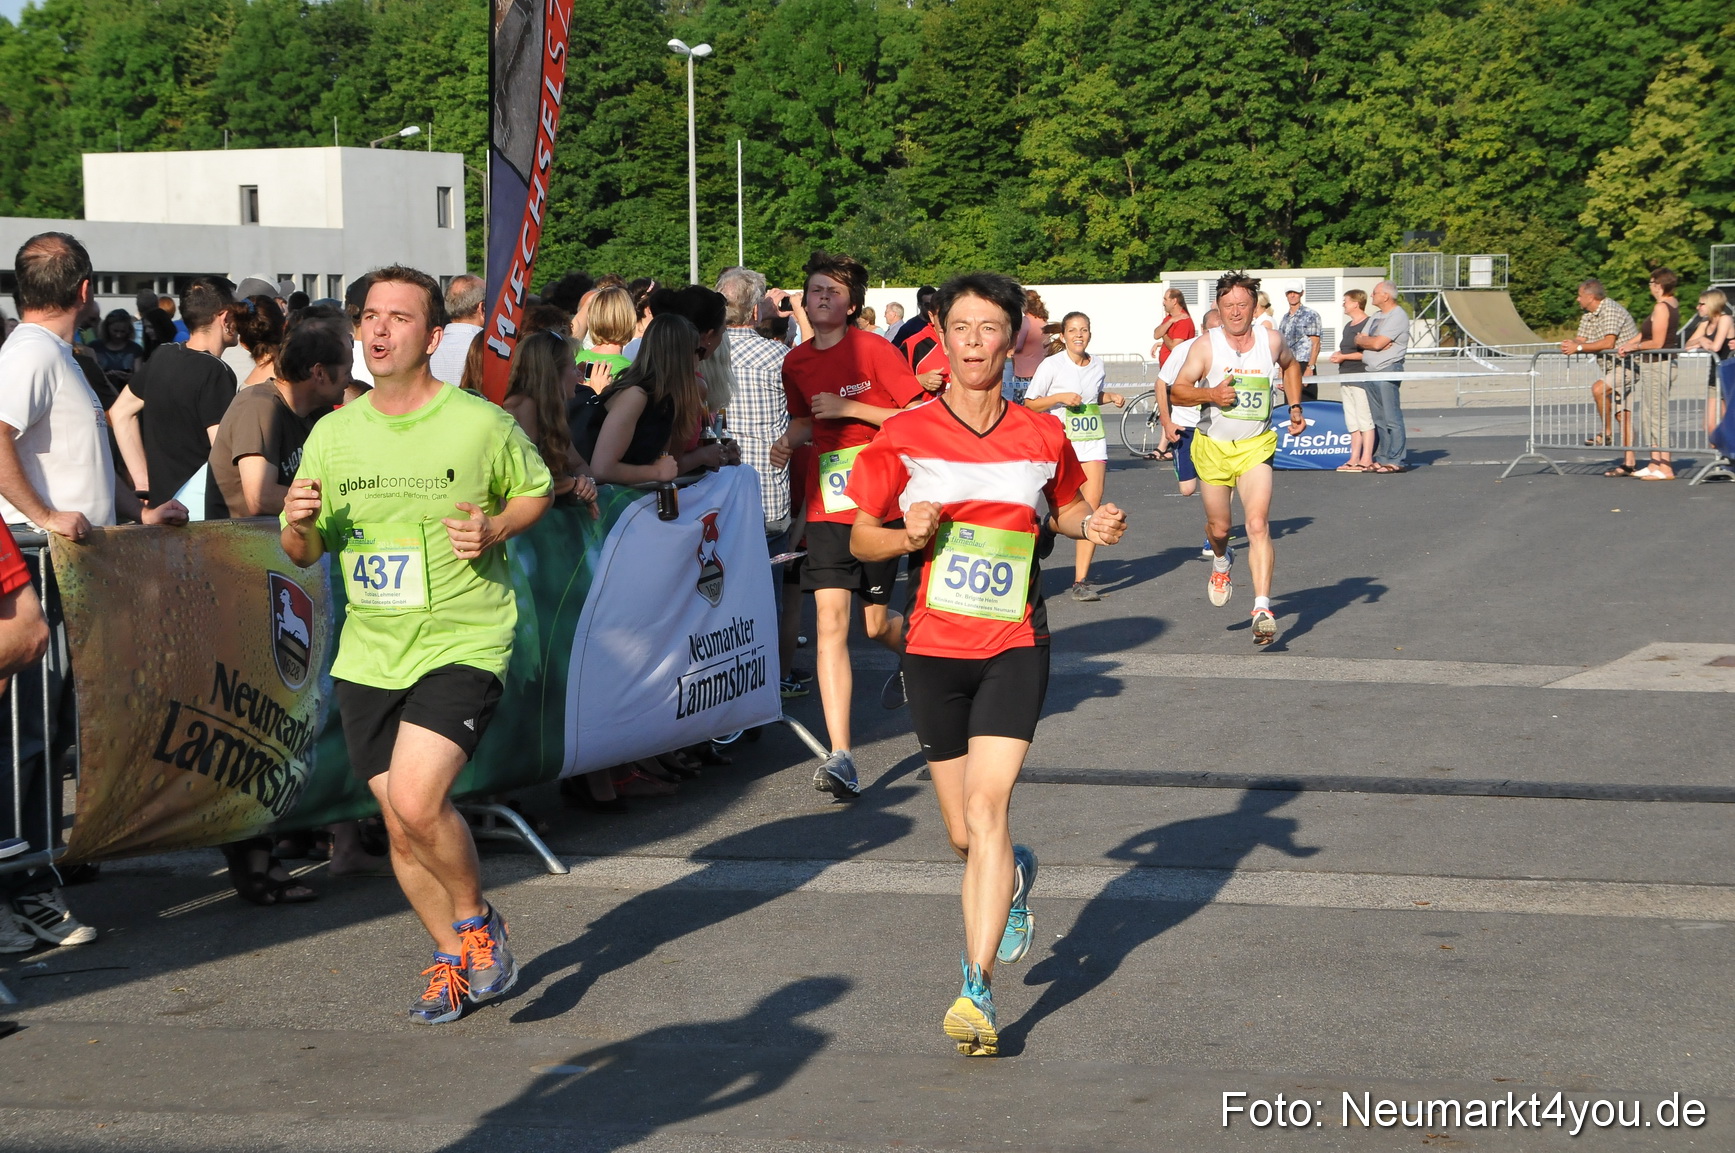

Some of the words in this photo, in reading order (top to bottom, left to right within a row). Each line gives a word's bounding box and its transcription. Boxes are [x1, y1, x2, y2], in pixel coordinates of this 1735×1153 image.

[846, 380, 871, 391] Petry
[1071, 416, 1098, 432] 900
[1289, 447, 1352, 456] AUTOMOBIL
[339, 474, 449, 496] globalconcepts
[829, 470, 852, 496] 9
[432, 493, 449, 501] Care.
[353, 555, 409, 590] 437
[944, 554, 1013, 597] 569
[688, 616, 754, 665] Neumarkter
[282, 656, 300, 681] 1628
[676, 648, 766, 720] Lammsbräu
[153, 700, 300, 817] Lammsb
